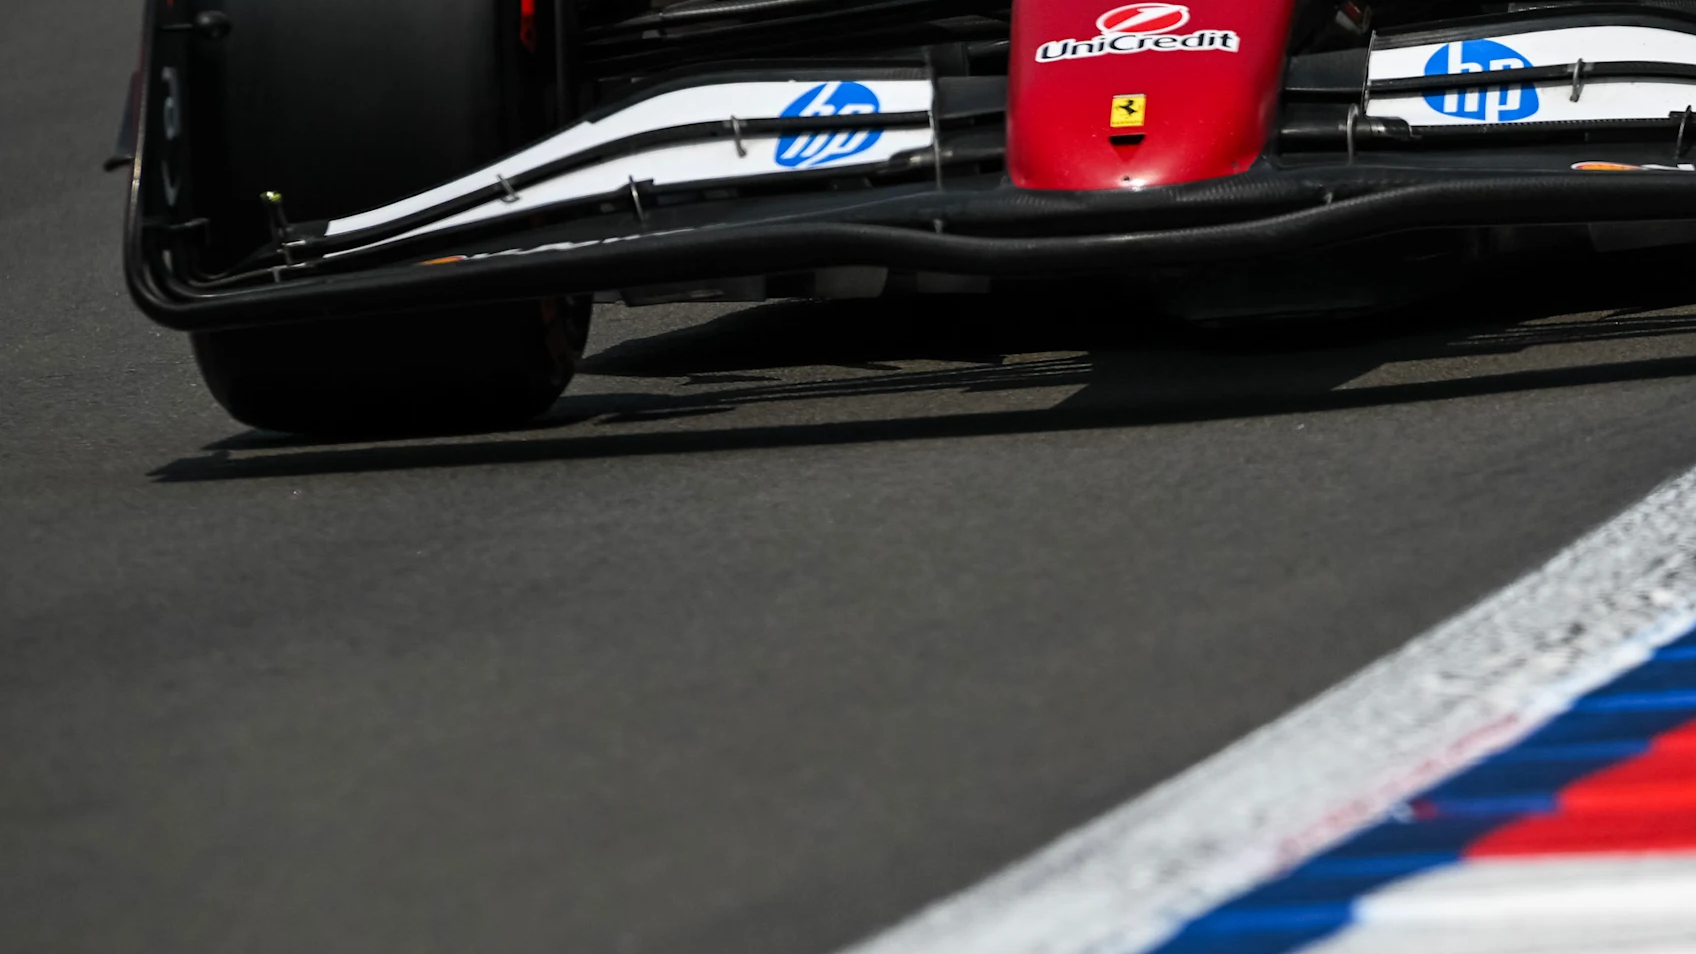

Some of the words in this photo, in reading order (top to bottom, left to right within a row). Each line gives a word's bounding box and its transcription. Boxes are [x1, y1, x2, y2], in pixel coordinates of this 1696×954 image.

[1038, 31, 1236, 62] UniCredit
[1442, 39, 1527, 123] hp
[779, 80, 879, 168] hp
